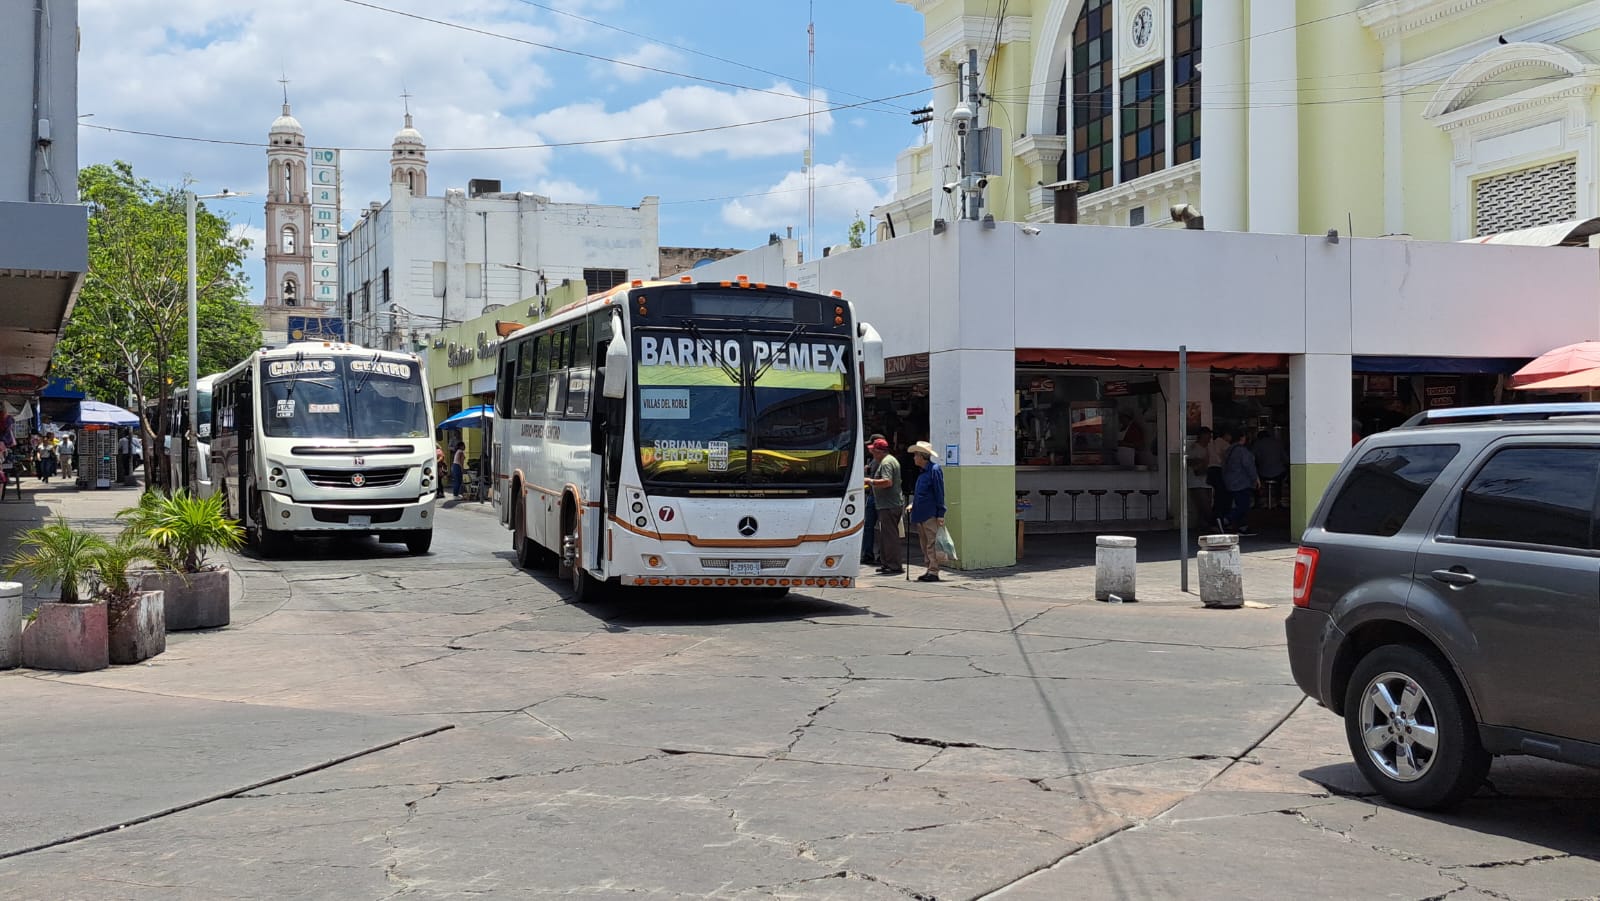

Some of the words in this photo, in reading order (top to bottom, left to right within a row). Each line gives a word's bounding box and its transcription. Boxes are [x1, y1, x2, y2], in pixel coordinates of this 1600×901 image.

[314, 151, 323, 161] El
[318, 170, 331, 295] Campeón
[641, 336, 740, 368] BARRIO
[752, 341, 848, 374] PEMEX
[350, 360, 410, 379] CENTRO
[642, 399, 660, 408] VILLAS
[661, 399, 671, 408] DEL
[672, 399, 688, 408] ROBLE
[654, 440, 703, 449] SORIANA
[654, 449, 703, 461] CENTRO
[662, 507, 671, 521] 7
